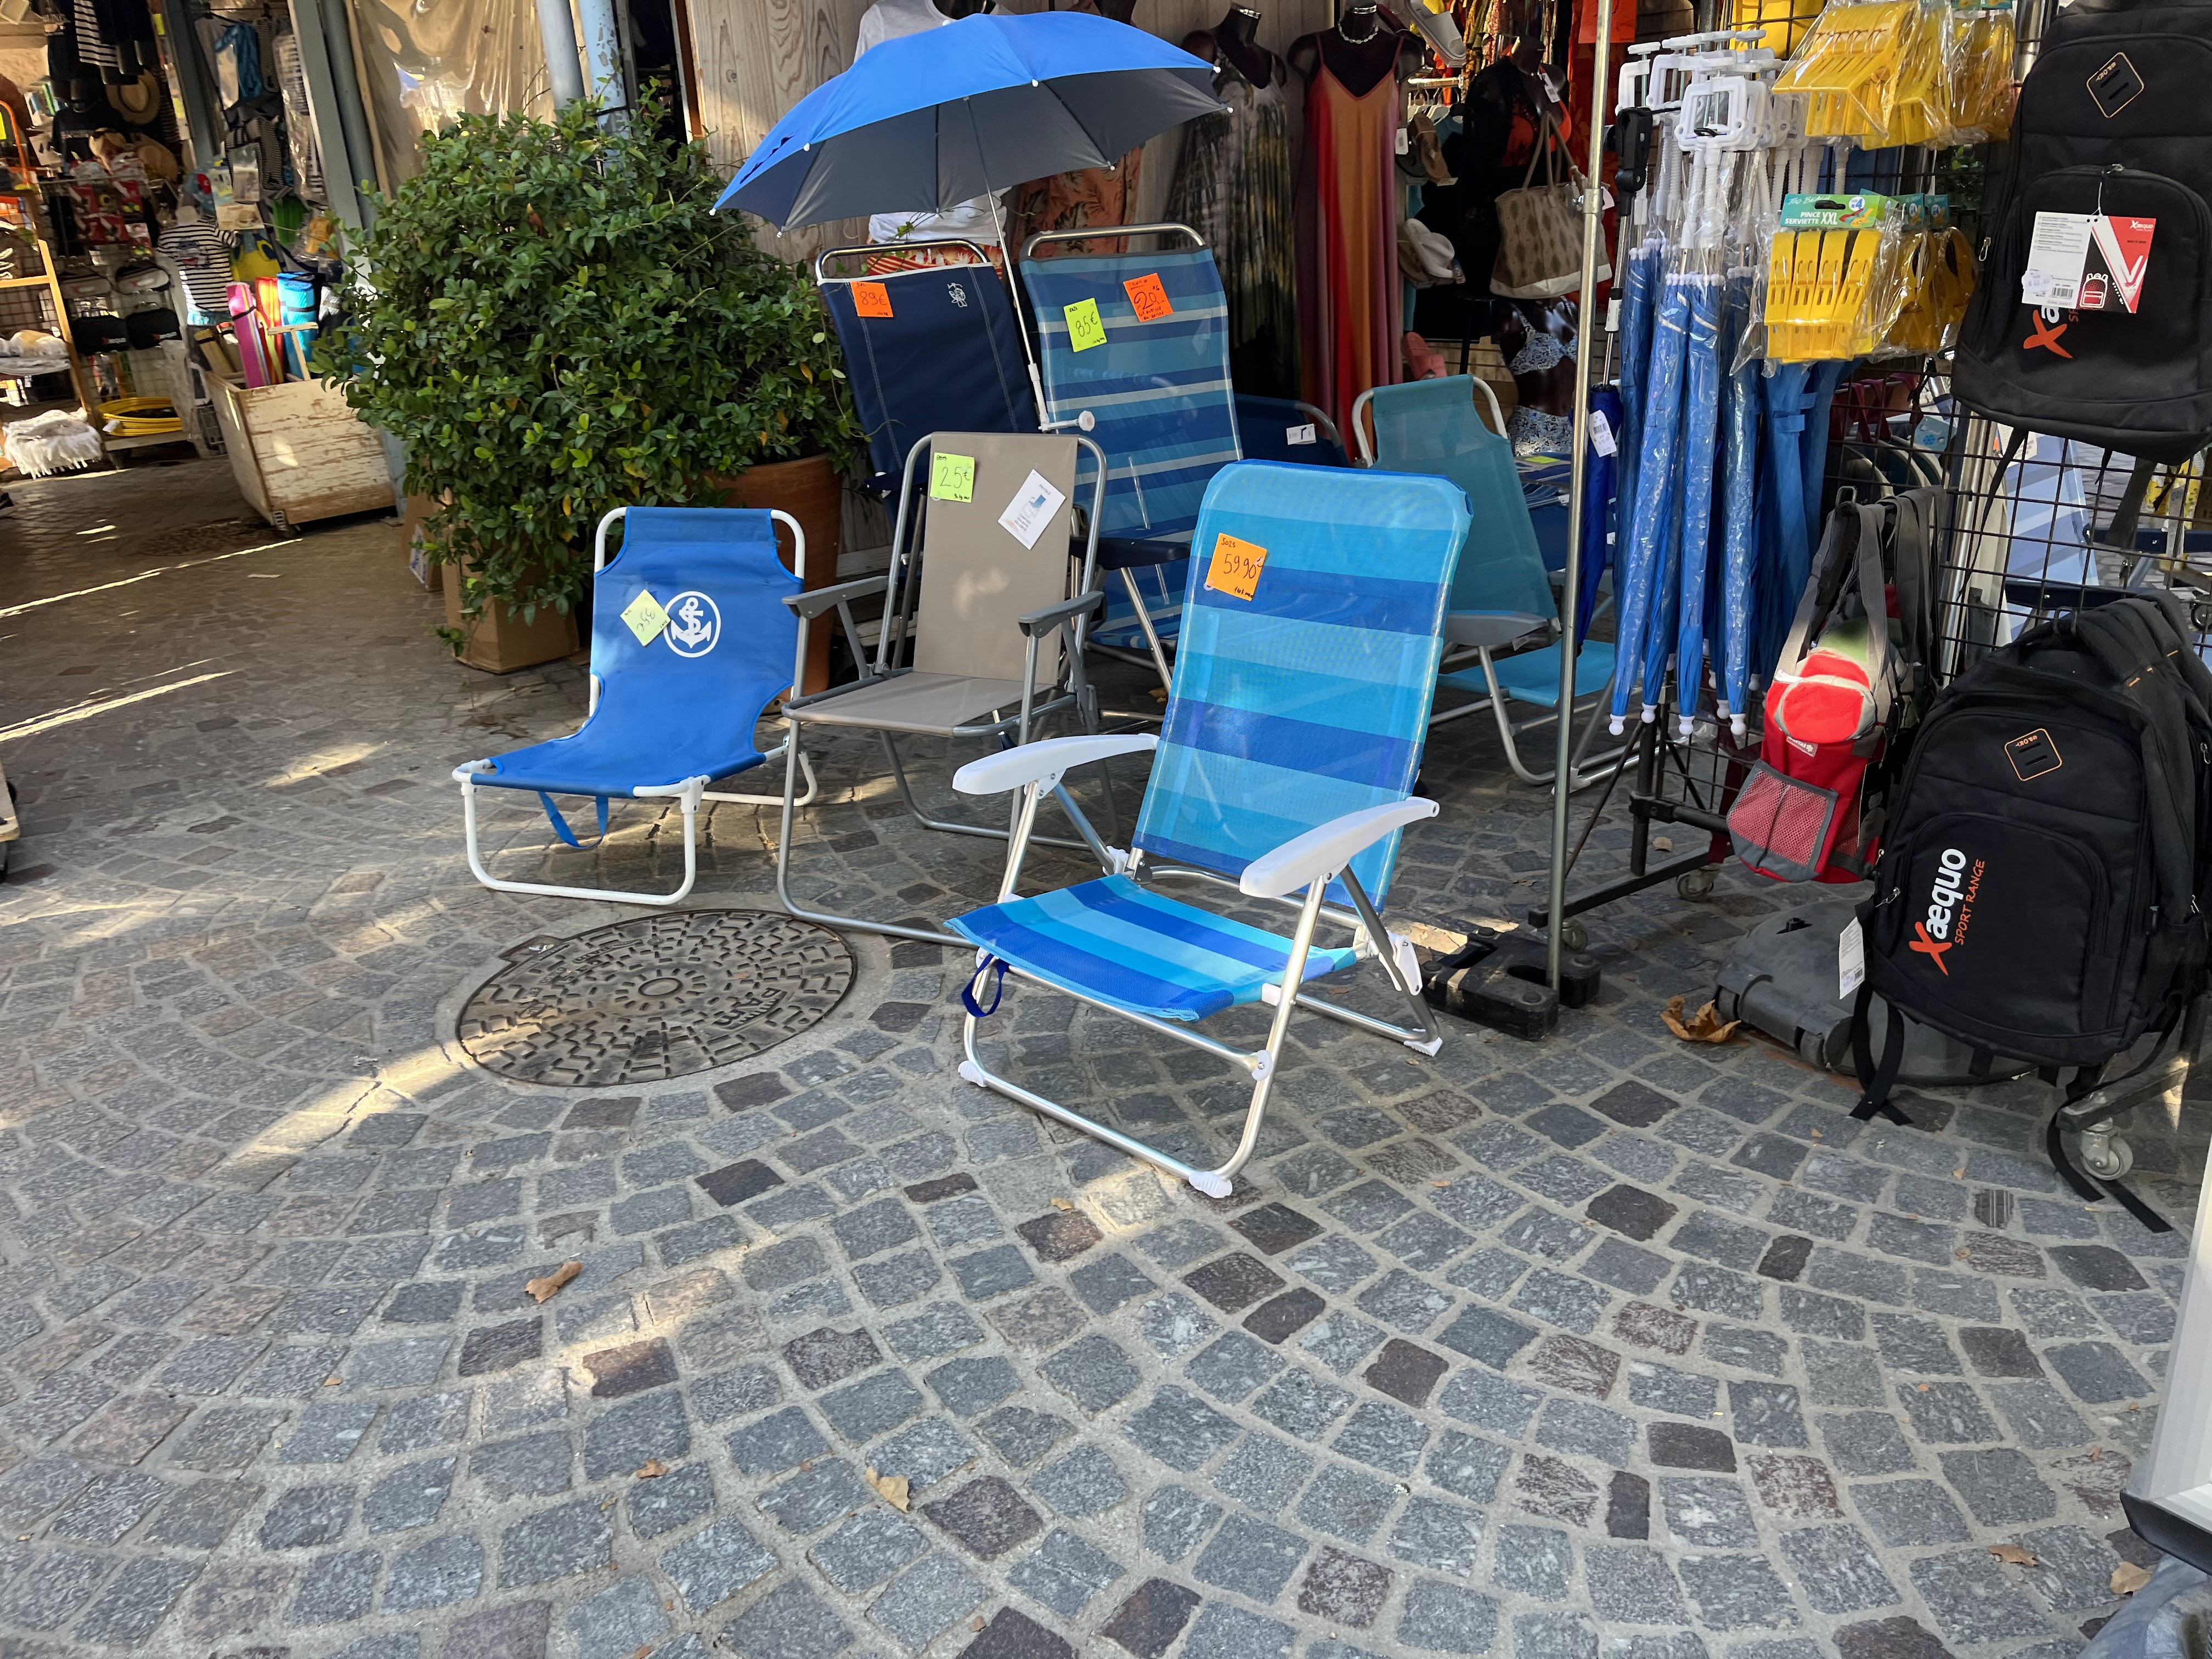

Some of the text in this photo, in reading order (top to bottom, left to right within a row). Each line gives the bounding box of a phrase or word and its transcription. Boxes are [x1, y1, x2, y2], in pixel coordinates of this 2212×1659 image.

[1820, 212, 1838, 225] XXL
[860, 291, 887, 305] 89€
[1076, 312, 1098, 337] 85€
[940, 467, 972, 488] 25€
[1955, 859, 1985, 945] SPORT RANGE
